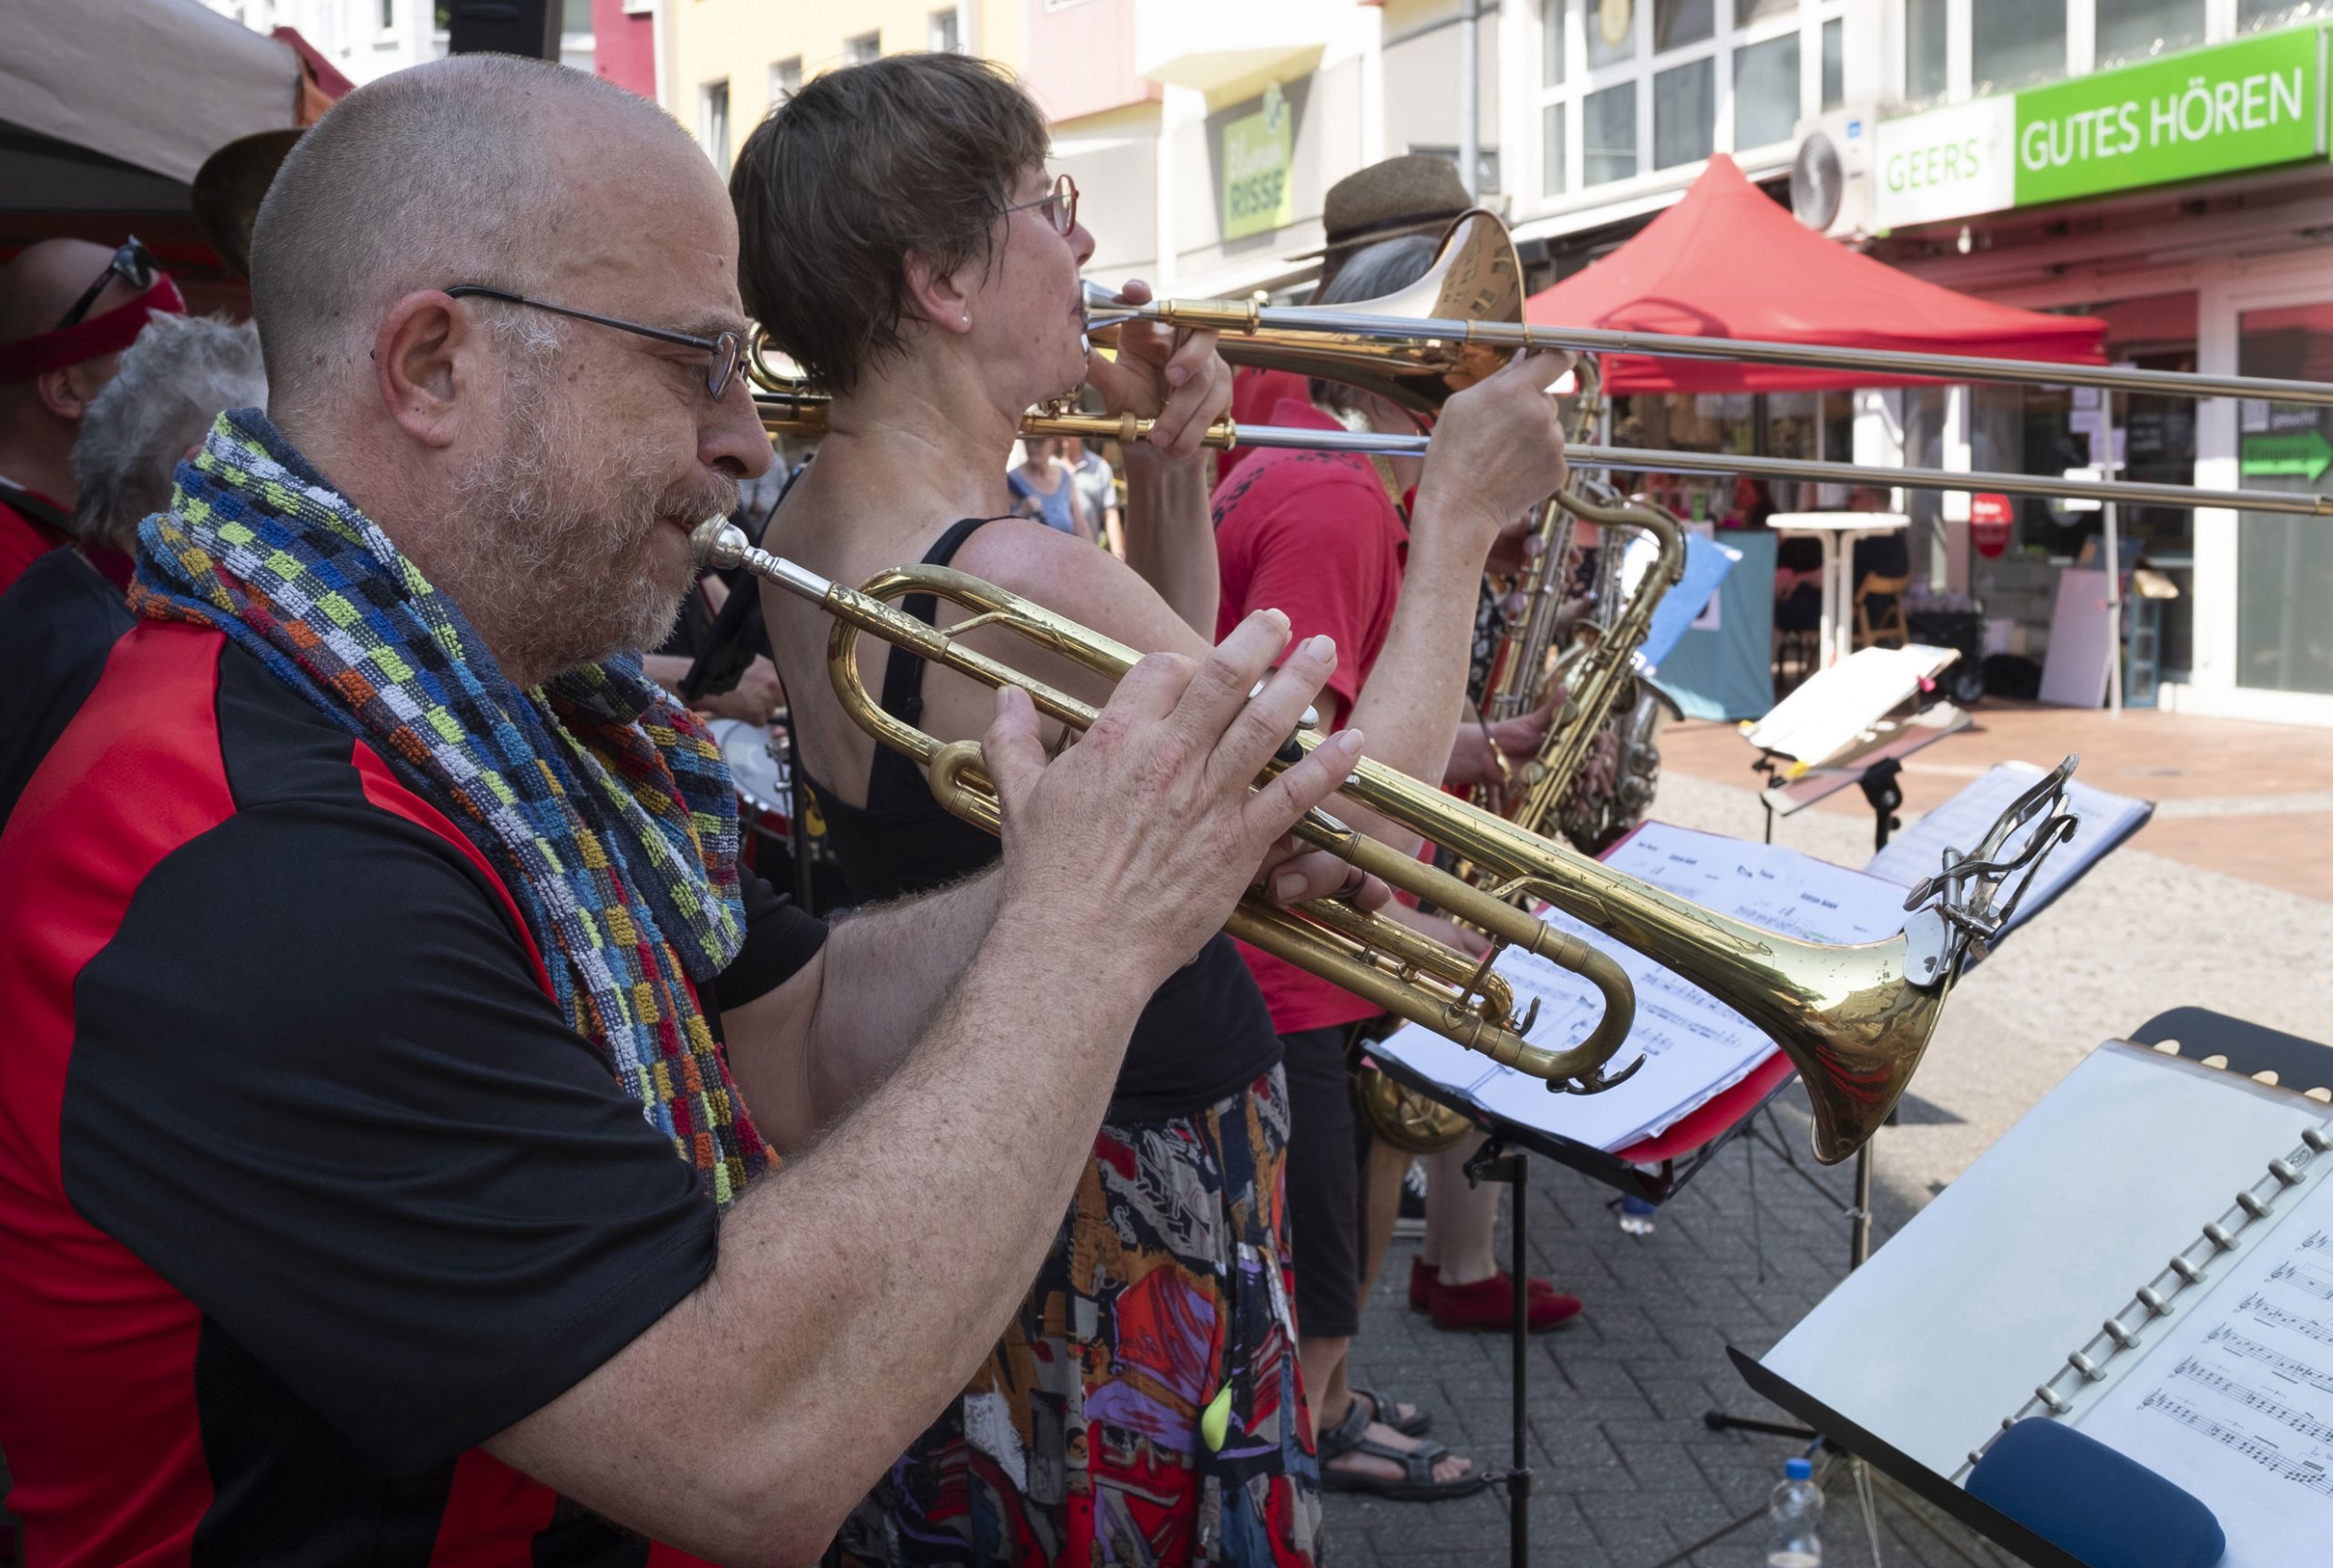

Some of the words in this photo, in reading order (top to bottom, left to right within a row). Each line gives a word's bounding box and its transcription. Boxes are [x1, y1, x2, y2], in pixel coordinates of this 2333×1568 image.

[2020, 101, 2141, 170] GUTES
[2150, 67, 2303, 147] HÖREN
[1887, 138, 1979, 192] GEERS
